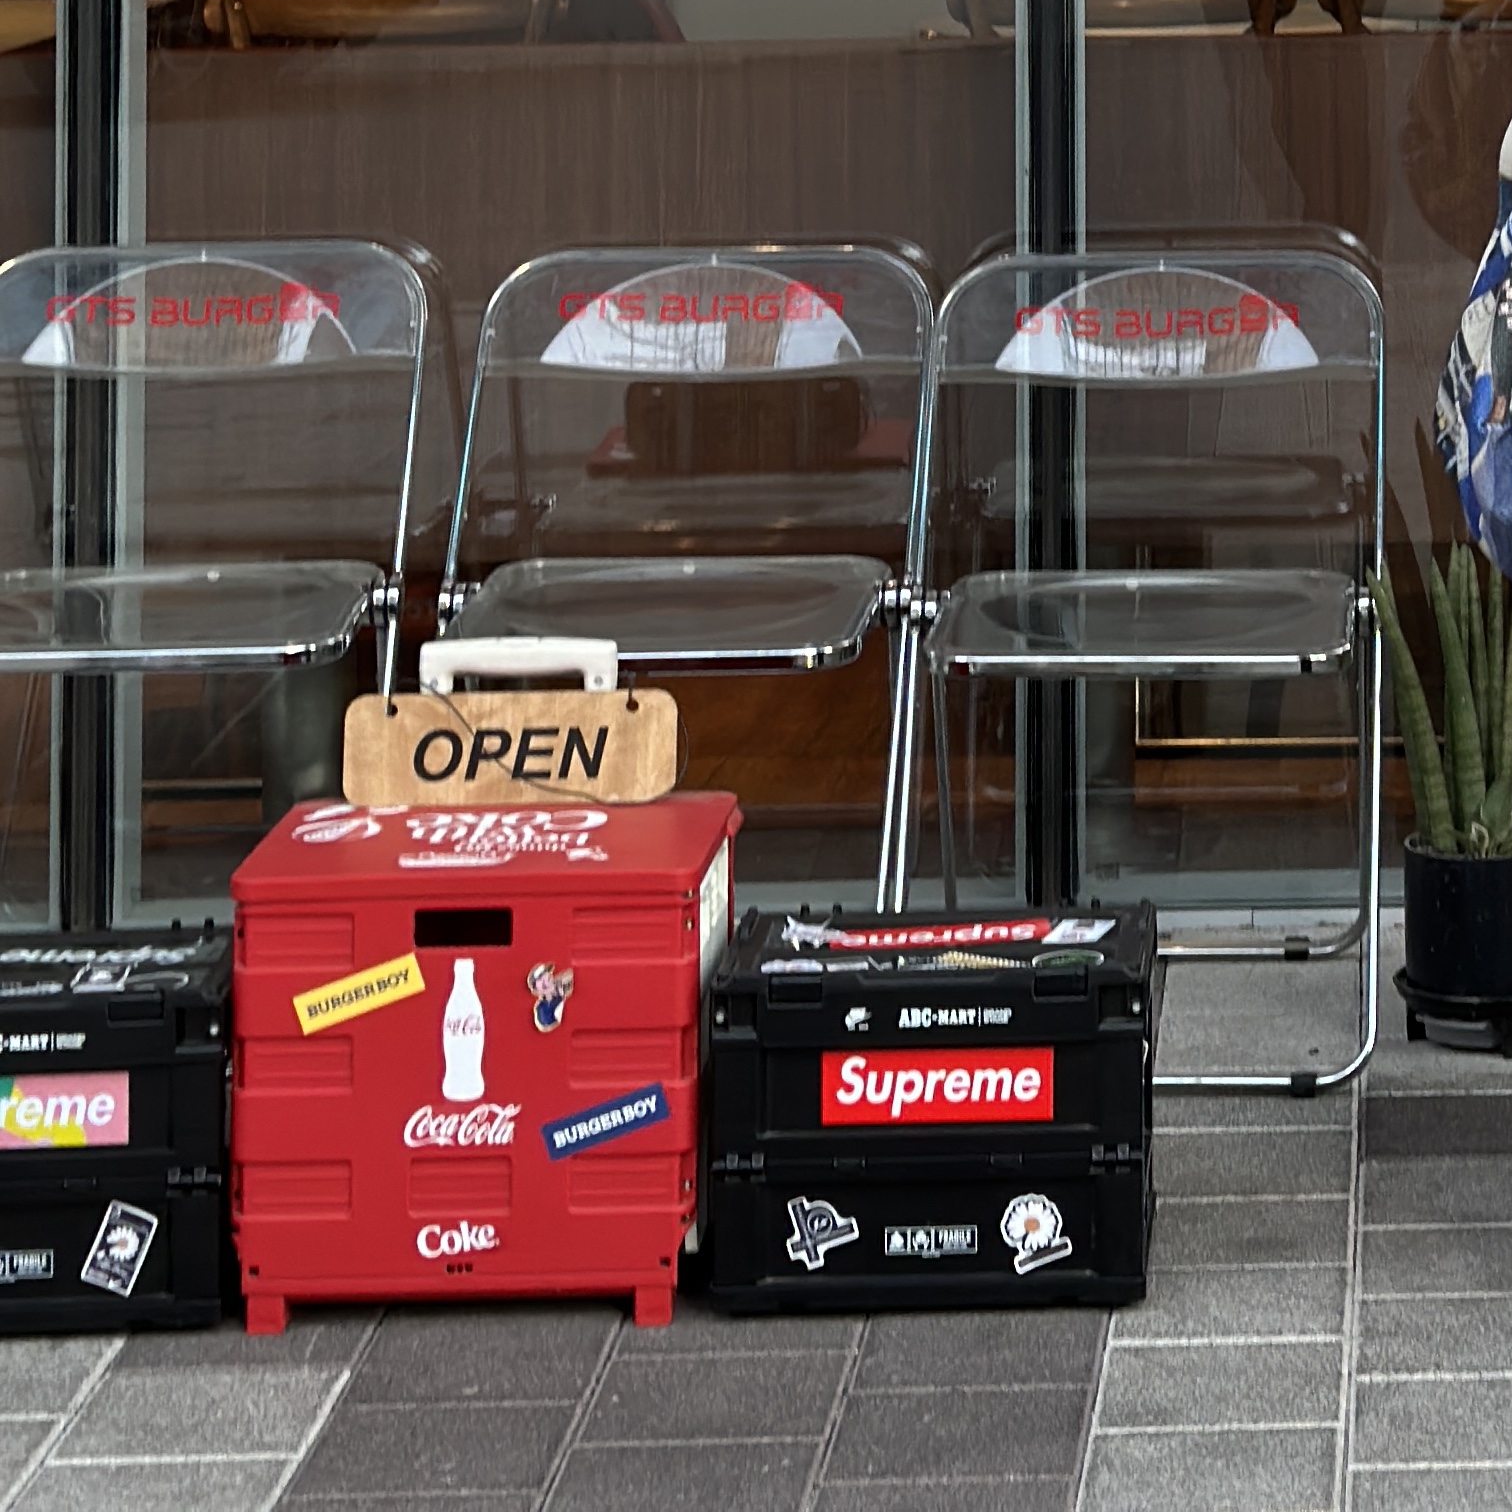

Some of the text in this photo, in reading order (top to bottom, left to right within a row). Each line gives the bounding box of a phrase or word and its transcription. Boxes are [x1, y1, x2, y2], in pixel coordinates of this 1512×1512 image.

[47, 295, 136, 326] GTS
[559, 282, 845, 322] GTS BURGER
[1015, 294, 1299, 339] GTS BURGER
[412, 725, 608, 782] OPEN
[836, 1055, 1042, 1118] Supreme
[416, 1221, 500, 1258] Coke
